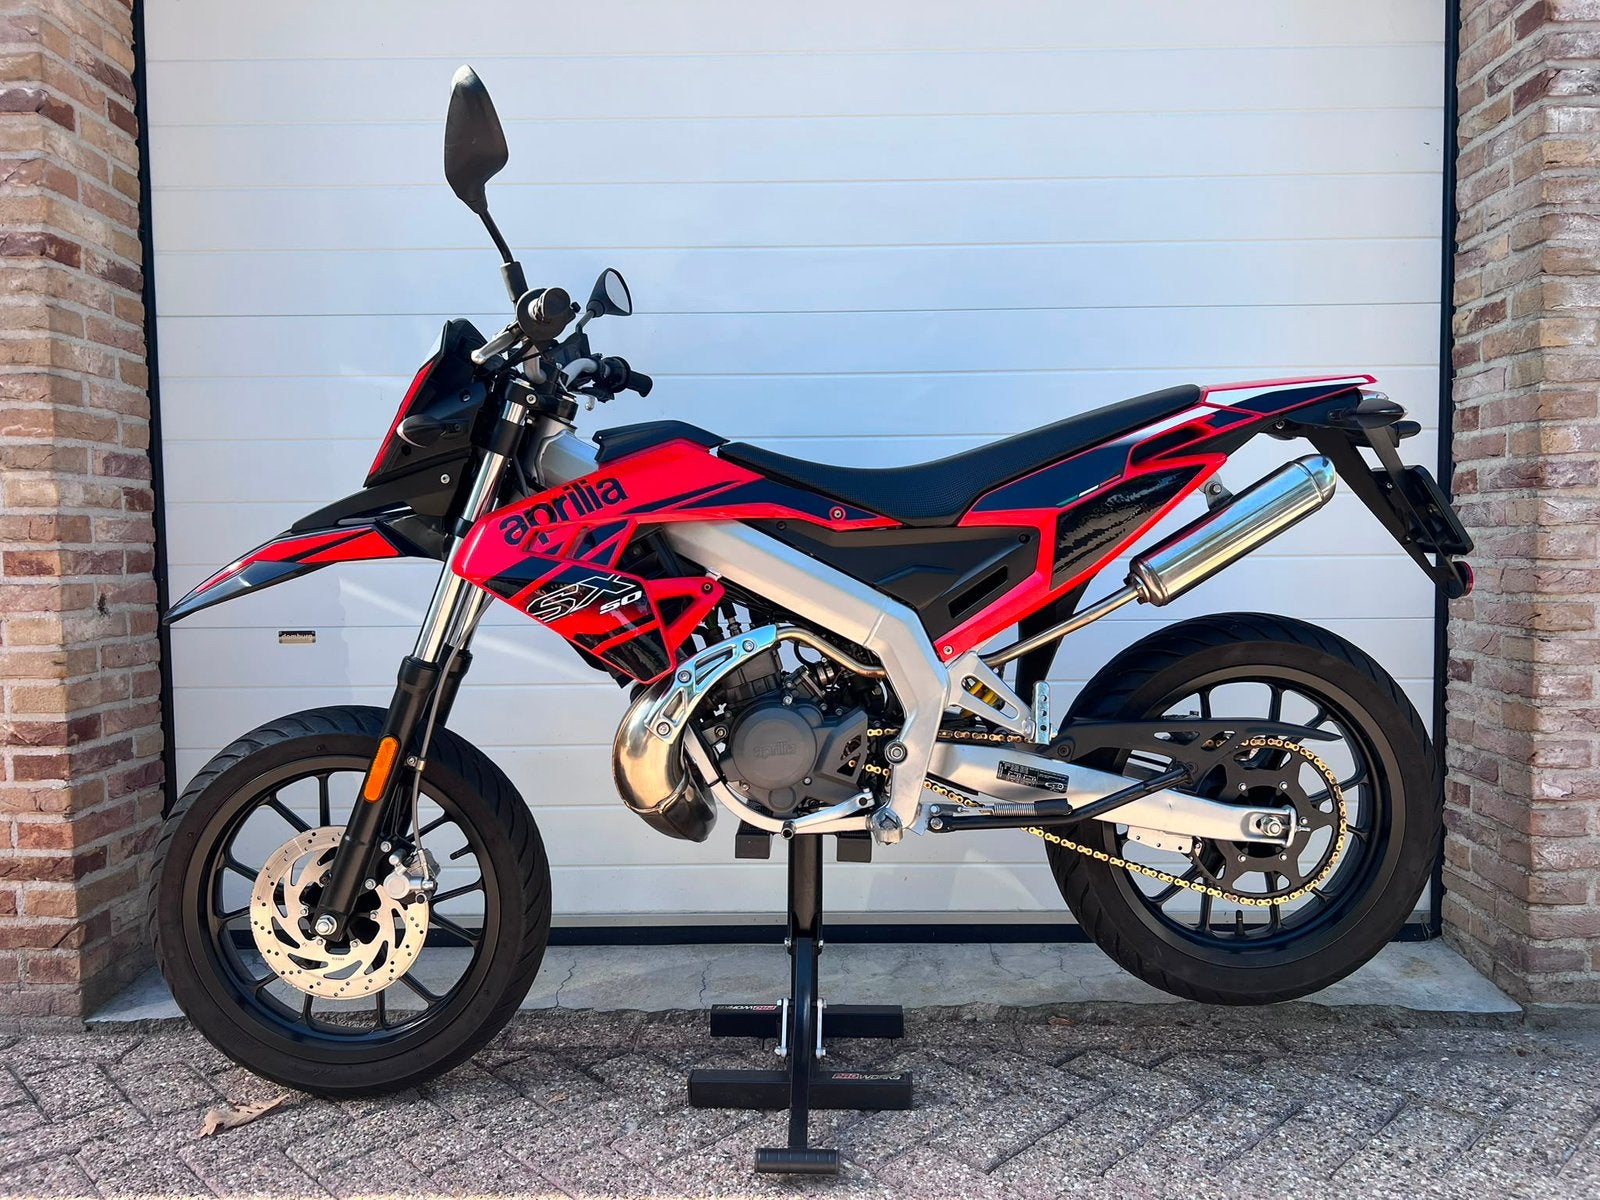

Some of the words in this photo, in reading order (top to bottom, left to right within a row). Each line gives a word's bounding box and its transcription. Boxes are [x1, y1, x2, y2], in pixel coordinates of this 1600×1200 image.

[499, 477, 629, 545] aprilia
[526, 574, 637, 623] SX
[600, 590, 643, 614] 50
[752, 740, 797, 760] aprilia
